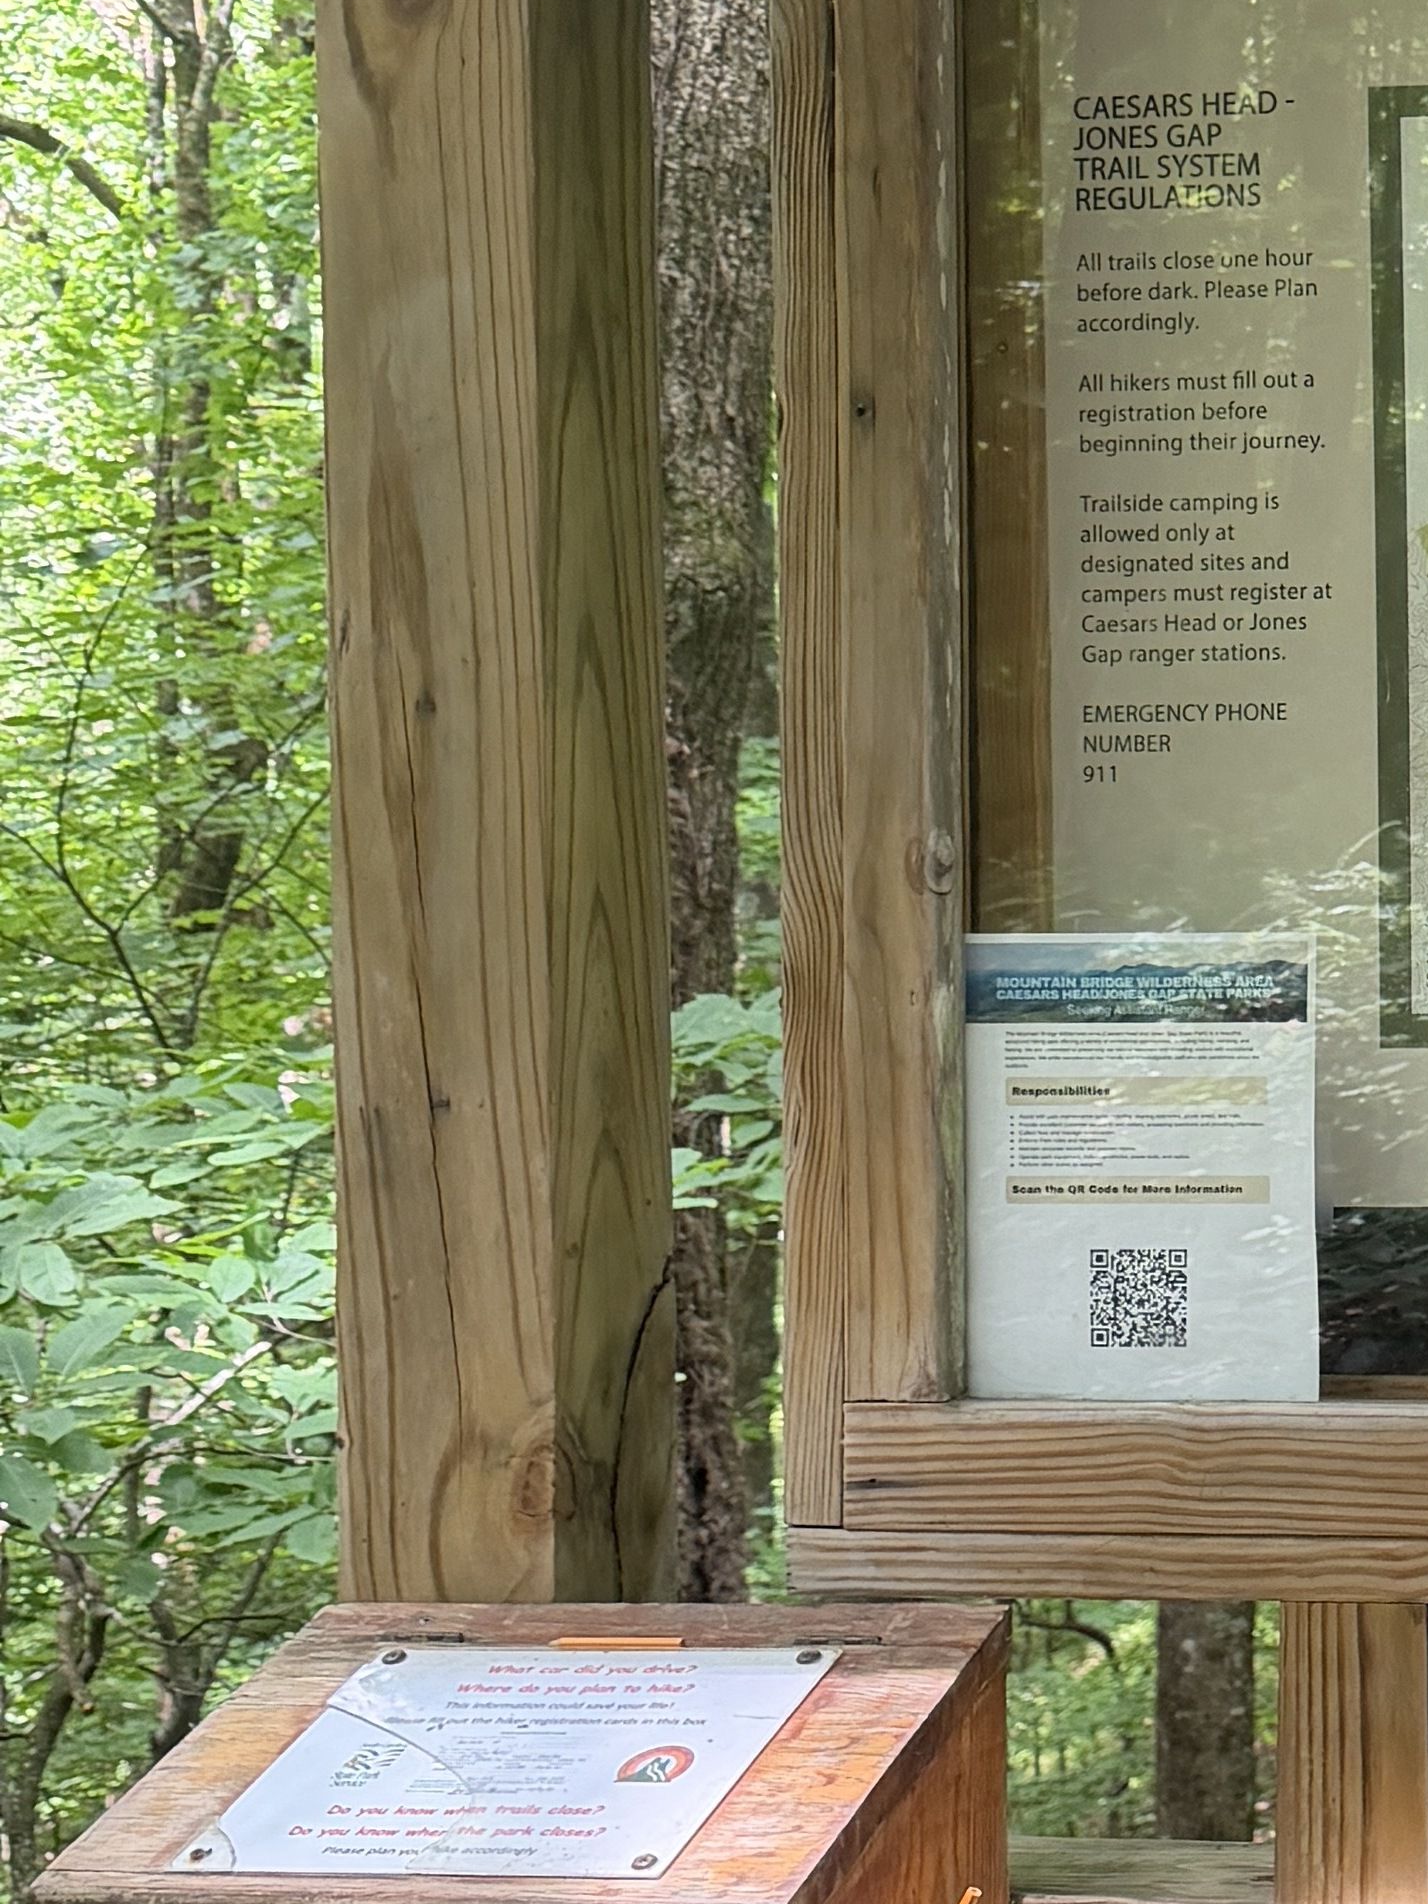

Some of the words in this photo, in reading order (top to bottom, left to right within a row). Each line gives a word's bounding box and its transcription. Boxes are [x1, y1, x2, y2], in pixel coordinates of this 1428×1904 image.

[1074, 94, 1193, 120] CAESARS
[1203, 91, 1277, 116] HEAD
[1073, 125, 1157, 150] JONES
[1167, 123, 1221, 147] GAP
[1074, 156, 1149, 180] TRAIL
[1157, 153, 1260, 178] SYSTEM
[1076, 183, 1260, 211] REGULATIONS
[1077, 253, 1101, 271] All
[1109, 252, 1156, 270] trails
[1163, 251, 1214, 269] close
[1266, 248, 1313, 266] hour
[1078, 283, 1141, 301] before
[1148, 281, 1198, 300] dark.
[1205, 280, 1268, 298] Please
[1276, 278, 1317, 296] Plan
[1078, 312, 1199, 334] accordingly.
[1079, 374, 1102, 392] All
[1111, 373, 1169, 391] hikers
[1177, 374, 1226, 390] must
[1233, 370, 1256, 389] fill
[1263, 372, 1297, 388] out
[1304, 375, 1315, 388] a
[1080, 404, 1194, 427] registration
[1203, 401, 1267, 420] before
[1080, 434, 1182, 457] beginning
[1190, 433, 1236, 451] their
[1243, 431, 1325, 454] journey.
[1080, 494, 1163, 512] Trailside
[1170, 493, 1257, 515] camping
[1266, 492, 1279, 509] is
[1081, 524, 1159, 542] allowed
[1166, 523, 1209, 545] only
[1216, 525, 1234, 540] at
[1081, 553, 1193, 577] designated
[1201, 554, 1244, 571] sites
[1252, 551, 1288, 570] and
[1082, 587, 1166, 607] campers
[1174, 584, 1223, 601] must
[1231, 583, 1307, 605] register
[1313, 583, 1332, 599] at
[1082, 615, 1157, 633] Caesars
[1165, 613, 1215, 631] Head
[1223, 618, 1244, 631] or
[1249, 613, 1306, 630] Jones
[1082, 645, 1122, 667] Gap
[1130, 648, 1195, 667] ranger
[1202, 644, 1285, 661] stations.
[1084, 704, 1208, 722] EMERGENCY
[1216, 703, 1287, 721] PHONE
[1084, 735, 1170, 752] NUMBER
[1084, 766, 1116, 782] 911
[1012, 1086, 1110, 1097] Responsibilities
[1012, 1185, 1041, 1194] Scan
[1068, 1185, 1085, 1194] QR
[1089, 1185, 1118, 1194] Code
[1175, 1184, 1243, 1194] Information
[488, 1664, 534, 1674] What
[643, 1664, 698, 1674] drive?
[457, 1684, 512, 1693] Where
[647, 1683, 696, 1693] hike?
